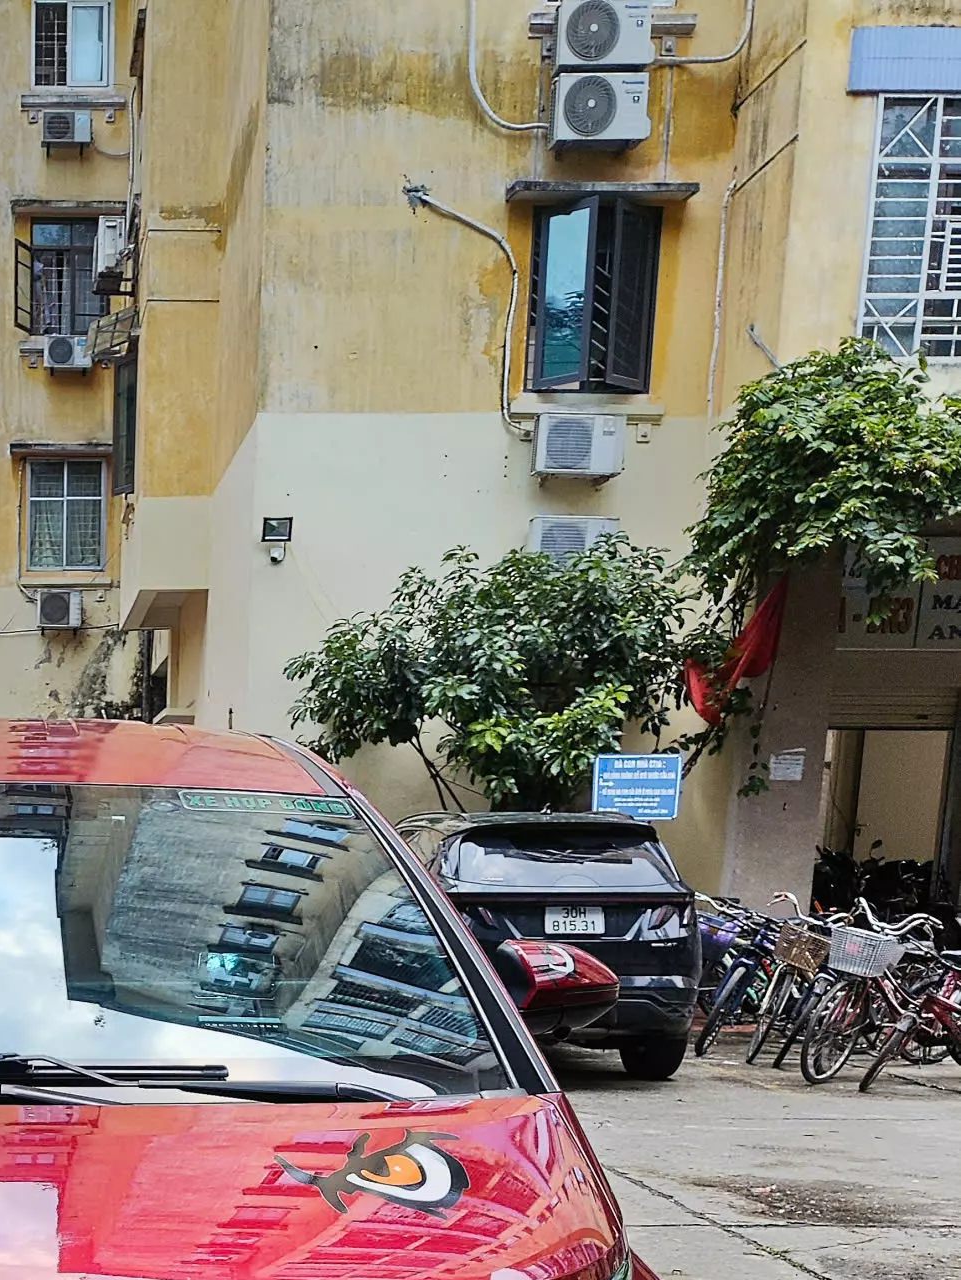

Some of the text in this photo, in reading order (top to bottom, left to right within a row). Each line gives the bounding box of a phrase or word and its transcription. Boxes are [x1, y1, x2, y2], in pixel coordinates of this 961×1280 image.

[185, 794, 220, 808] XE
[562, 907, 587, 919] 30H
[552, 920, 596, 932] 815.31
